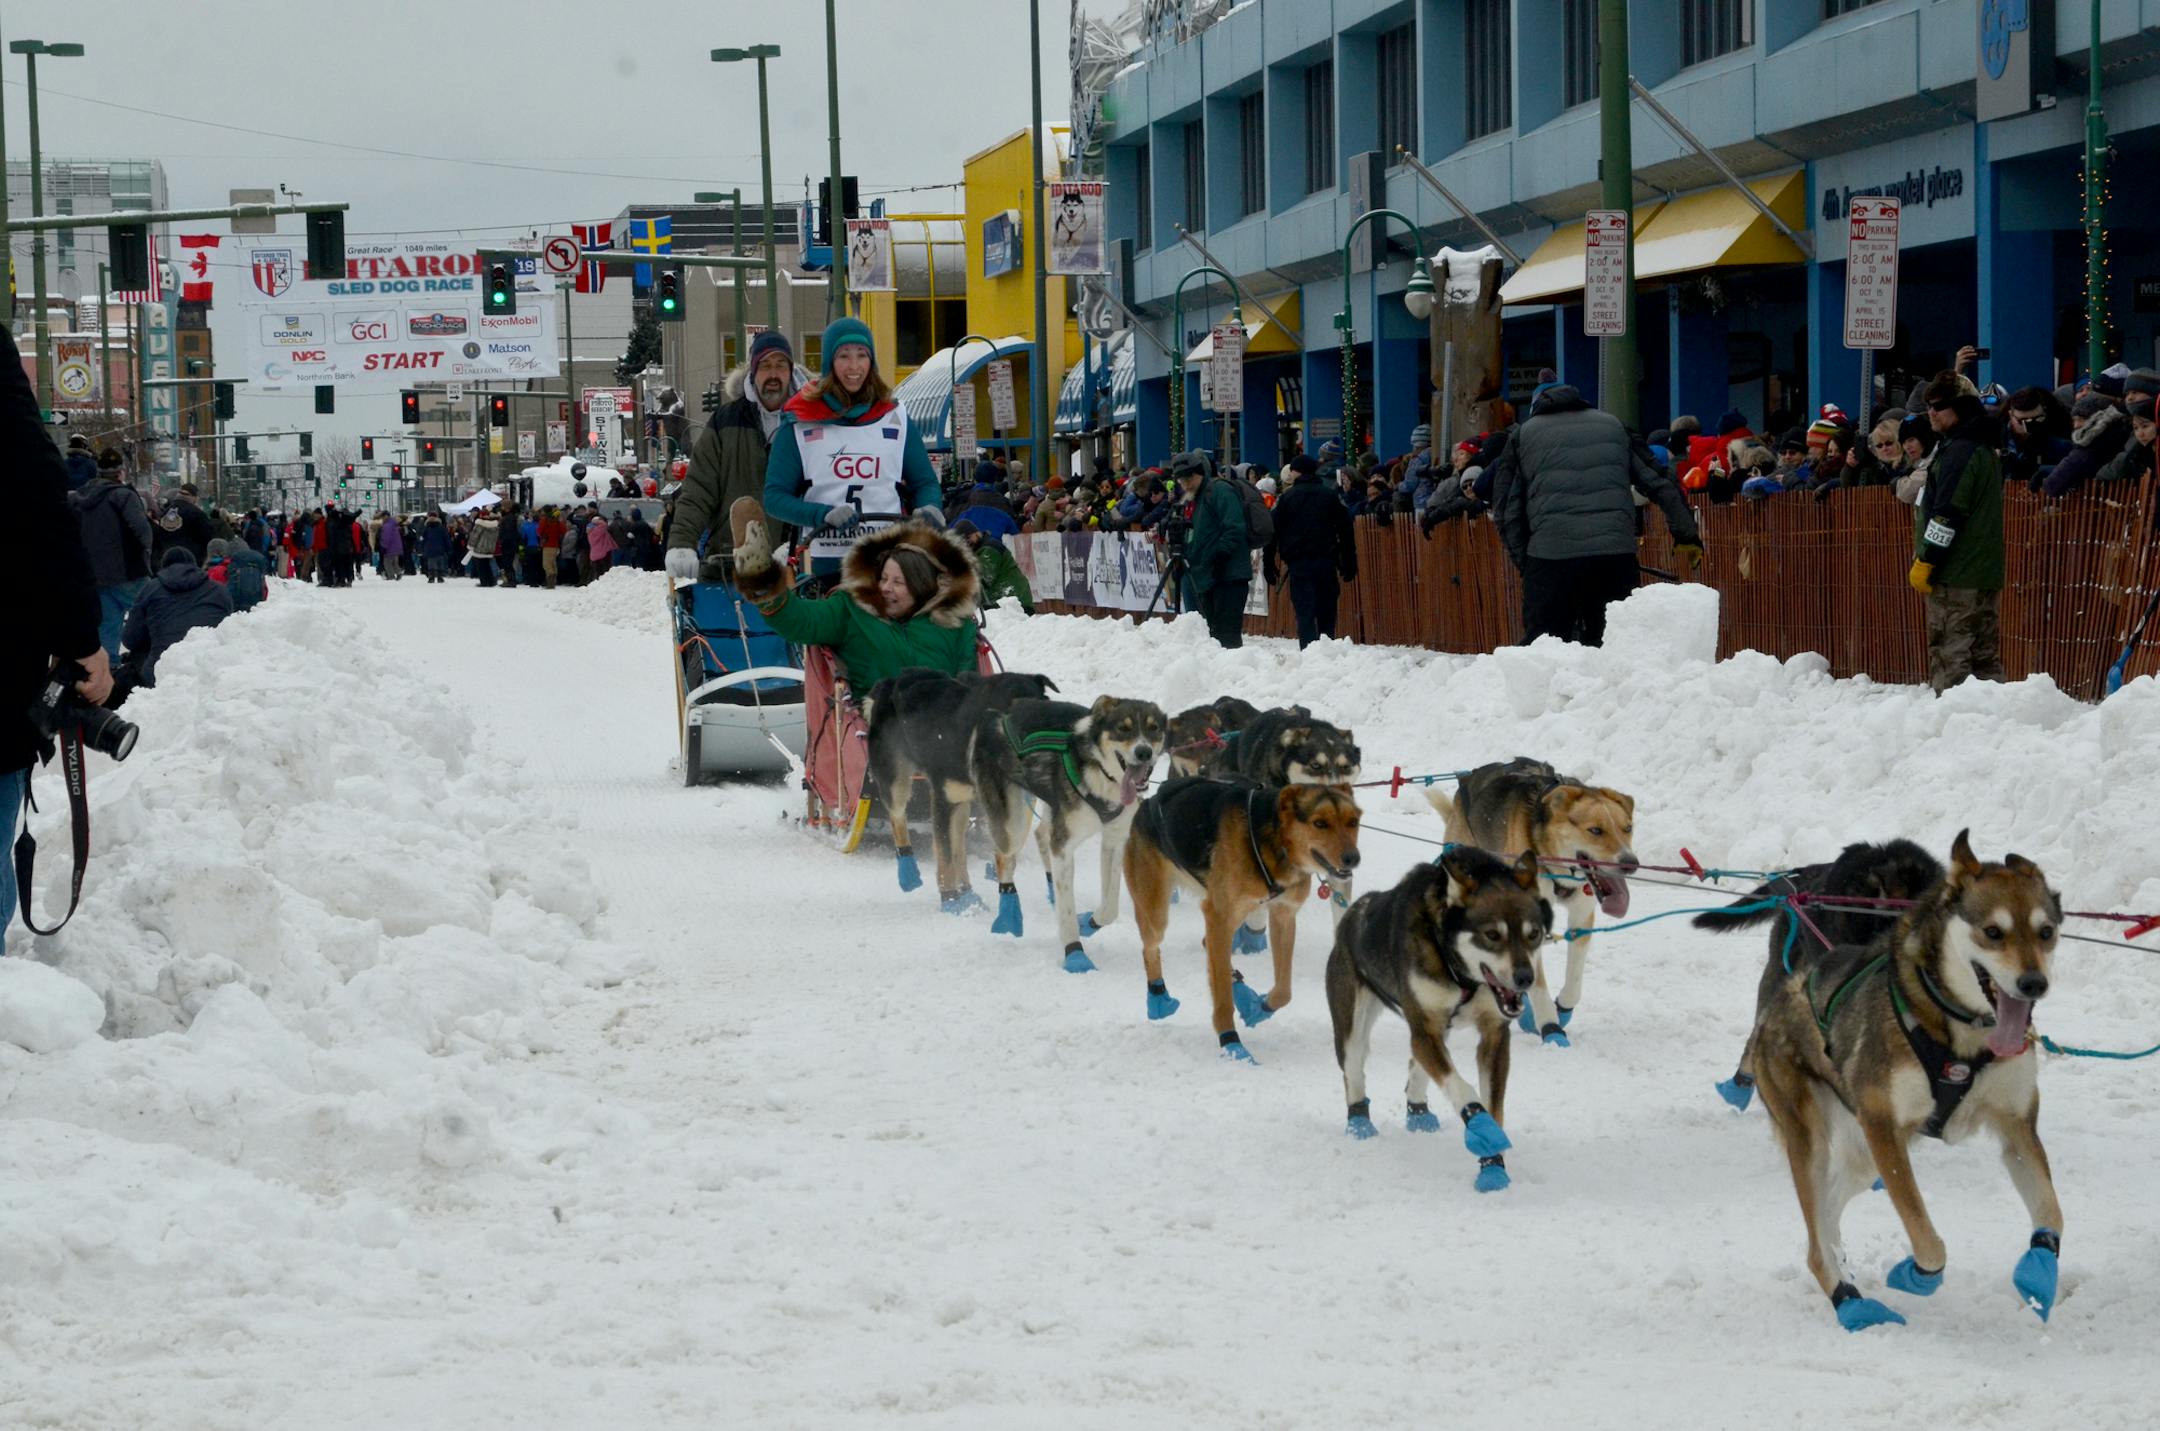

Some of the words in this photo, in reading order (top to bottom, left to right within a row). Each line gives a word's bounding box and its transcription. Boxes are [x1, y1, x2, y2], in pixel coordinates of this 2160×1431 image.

[1051, 184, 1102, 197] IDITAROD
[1928, 166, 1962, 208] place
[1851, 222, 1866, 238] NO
[1867, 225, 1897, 235] PARKING
[1588, 231, 1600, 245] NO
[1600, 233, 1624, 242] PARKING
[347, 247, 370, 255] Great
[1612, 257, 1622, 267] AM
[1880, 254, 1893, 265] AM
[1612, 275, 1622, 284] AM
[1880, 275, 1892, 285] AM
[328, 282, 375, 296] SLED
[380, 280, 421, 294] DOG
[424, 278, 474, 292] RACE
[1592, 311, 1617, 320] STREET
[481, 315, 538, 329] ExxonMobil
[1588, 321, 1622, 330] CLEANING
[1855, 319, 1885, 329] STREET
[351, 323, 387, 341] GCI
[1849, 330, 1890, 340] CLEANING
[488, 343, 531, 353] Matson
[363, 351, 445, 371] START
[335, 371, 356, 380] Bank
[833, 456, 880, 480] GCI
[845, 484, 864, 516] 5
[66, 739, 81, 796] DIGITAL
